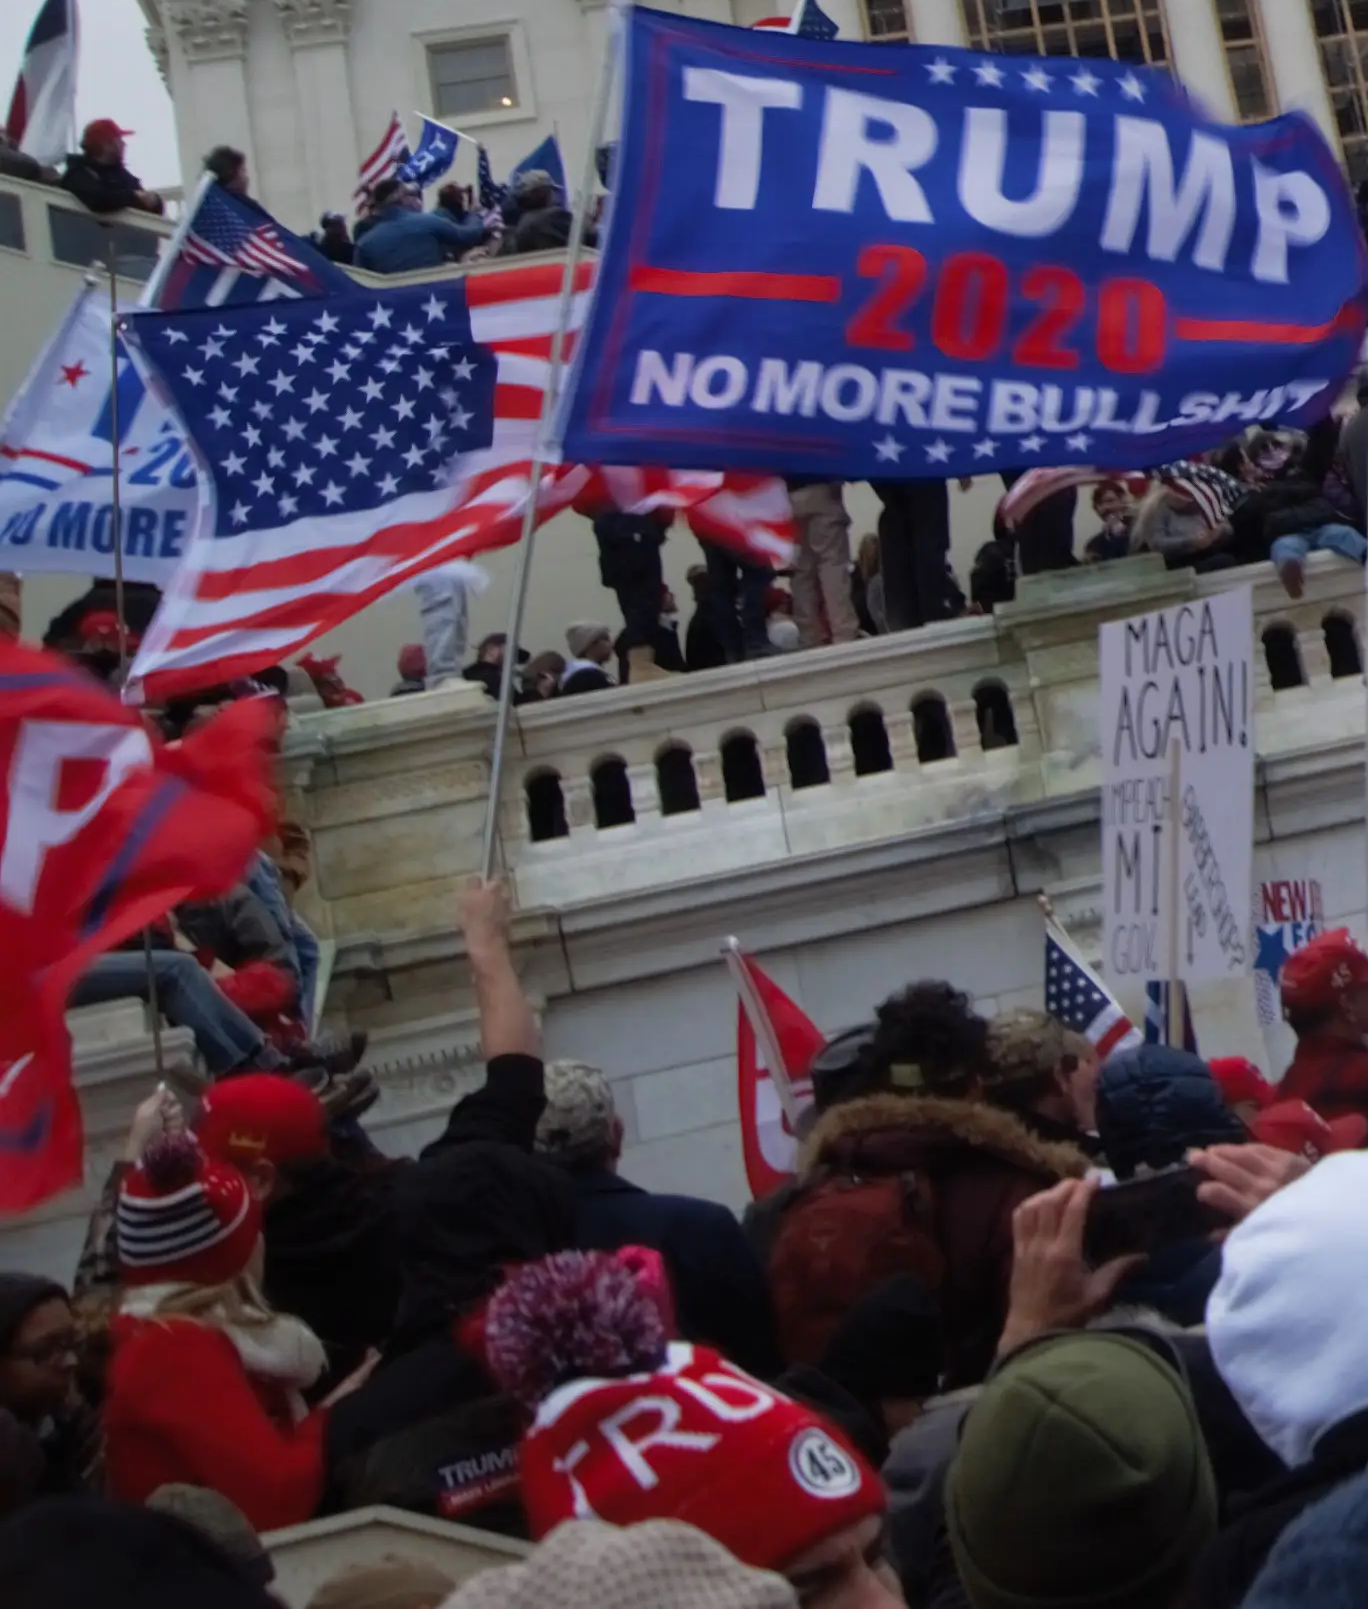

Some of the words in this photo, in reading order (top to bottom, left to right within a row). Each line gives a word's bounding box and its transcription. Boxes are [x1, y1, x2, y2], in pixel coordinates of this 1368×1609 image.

[681, 66, 1332, 284] TRUMP
[844, 243, 1167, 374] 2020
[630, 348, 750, 409] NO
[751, 356, 984, 428] MORE
[987, 378, 1330, 435] BULLSHIT
[46, 500, 187, 558] MORE
[1124, 600, 1219, 679] MAGA
[1113, 659, 1248, 768] AGAIN!
[1115, 823, 1162, 917] MI
[1261, 879, 1306, 922] NEW
[807, 1443, 848, 1482] 45
